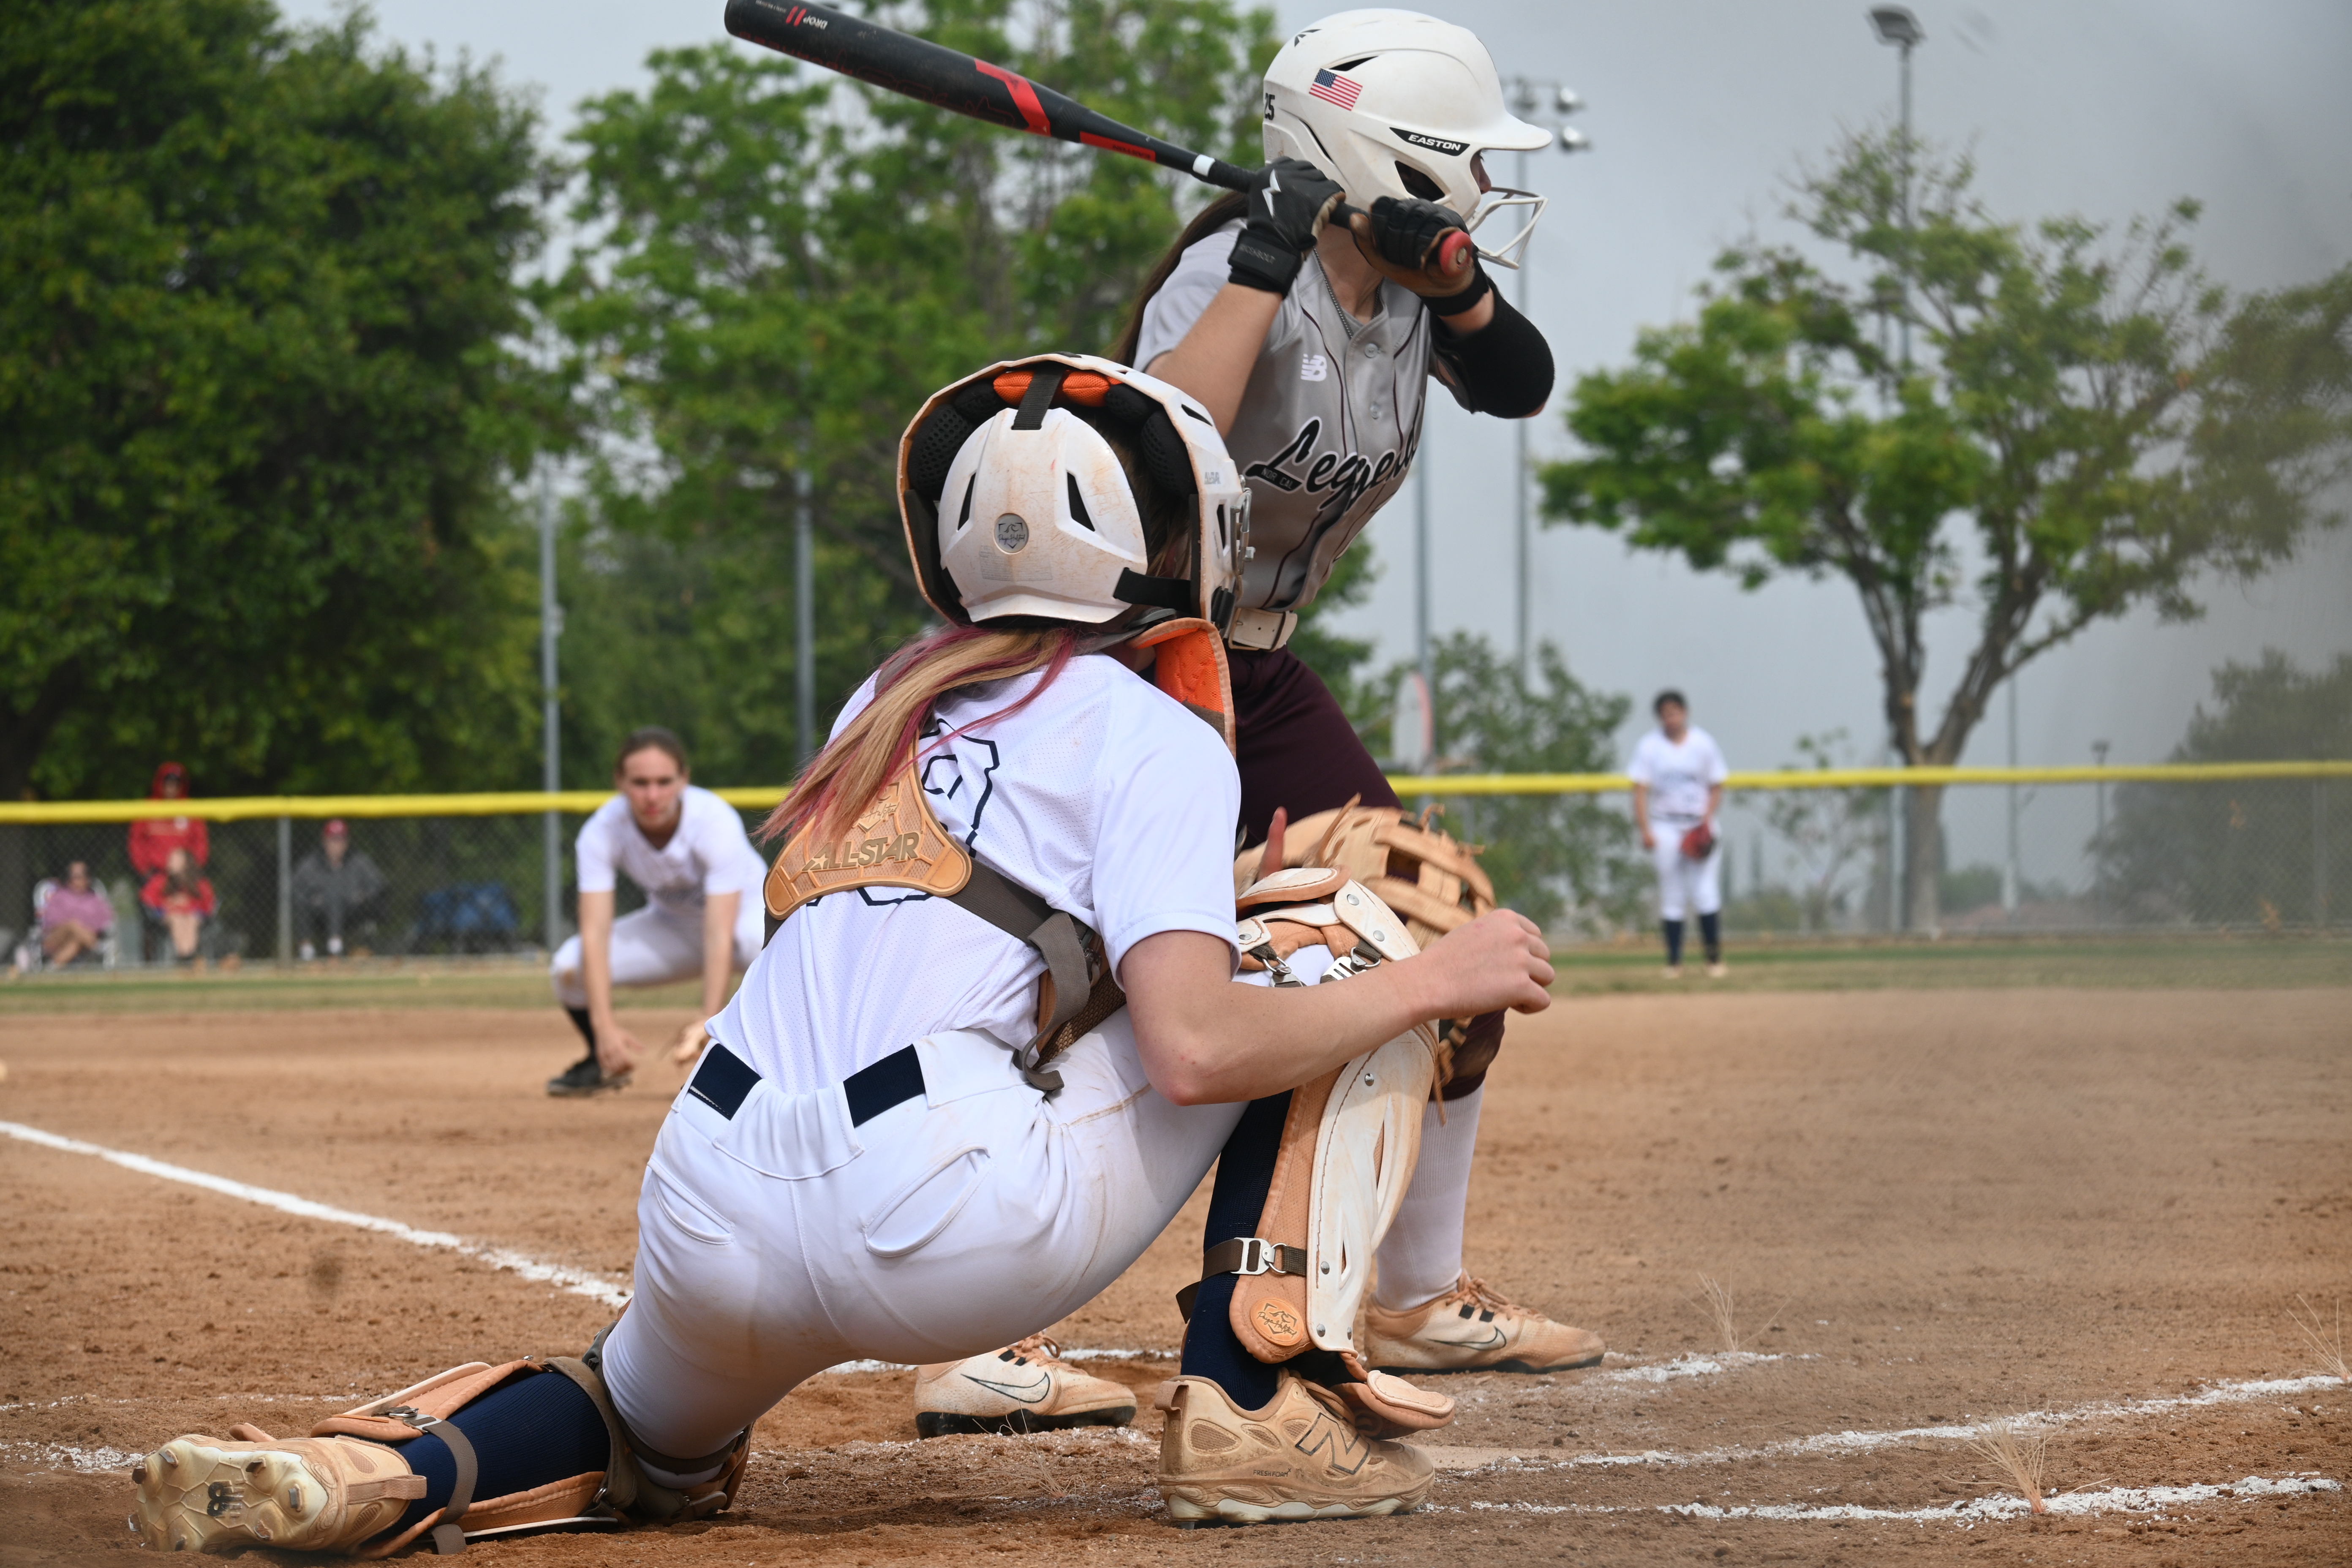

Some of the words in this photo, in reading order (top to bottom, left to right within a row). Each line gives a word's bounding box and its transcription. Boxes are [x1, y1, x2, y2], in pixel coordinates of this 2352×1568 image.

[803, 15, 828, 30] DROP
[1265, 93, 1275, 120] 25
[1408, 134, 1461, 151] EASTON
[1261, 468, 1278, 481] NOR
[1279, 477, 1293, 490] CAL
[802, 832, 920, 871] ALL-STAR
